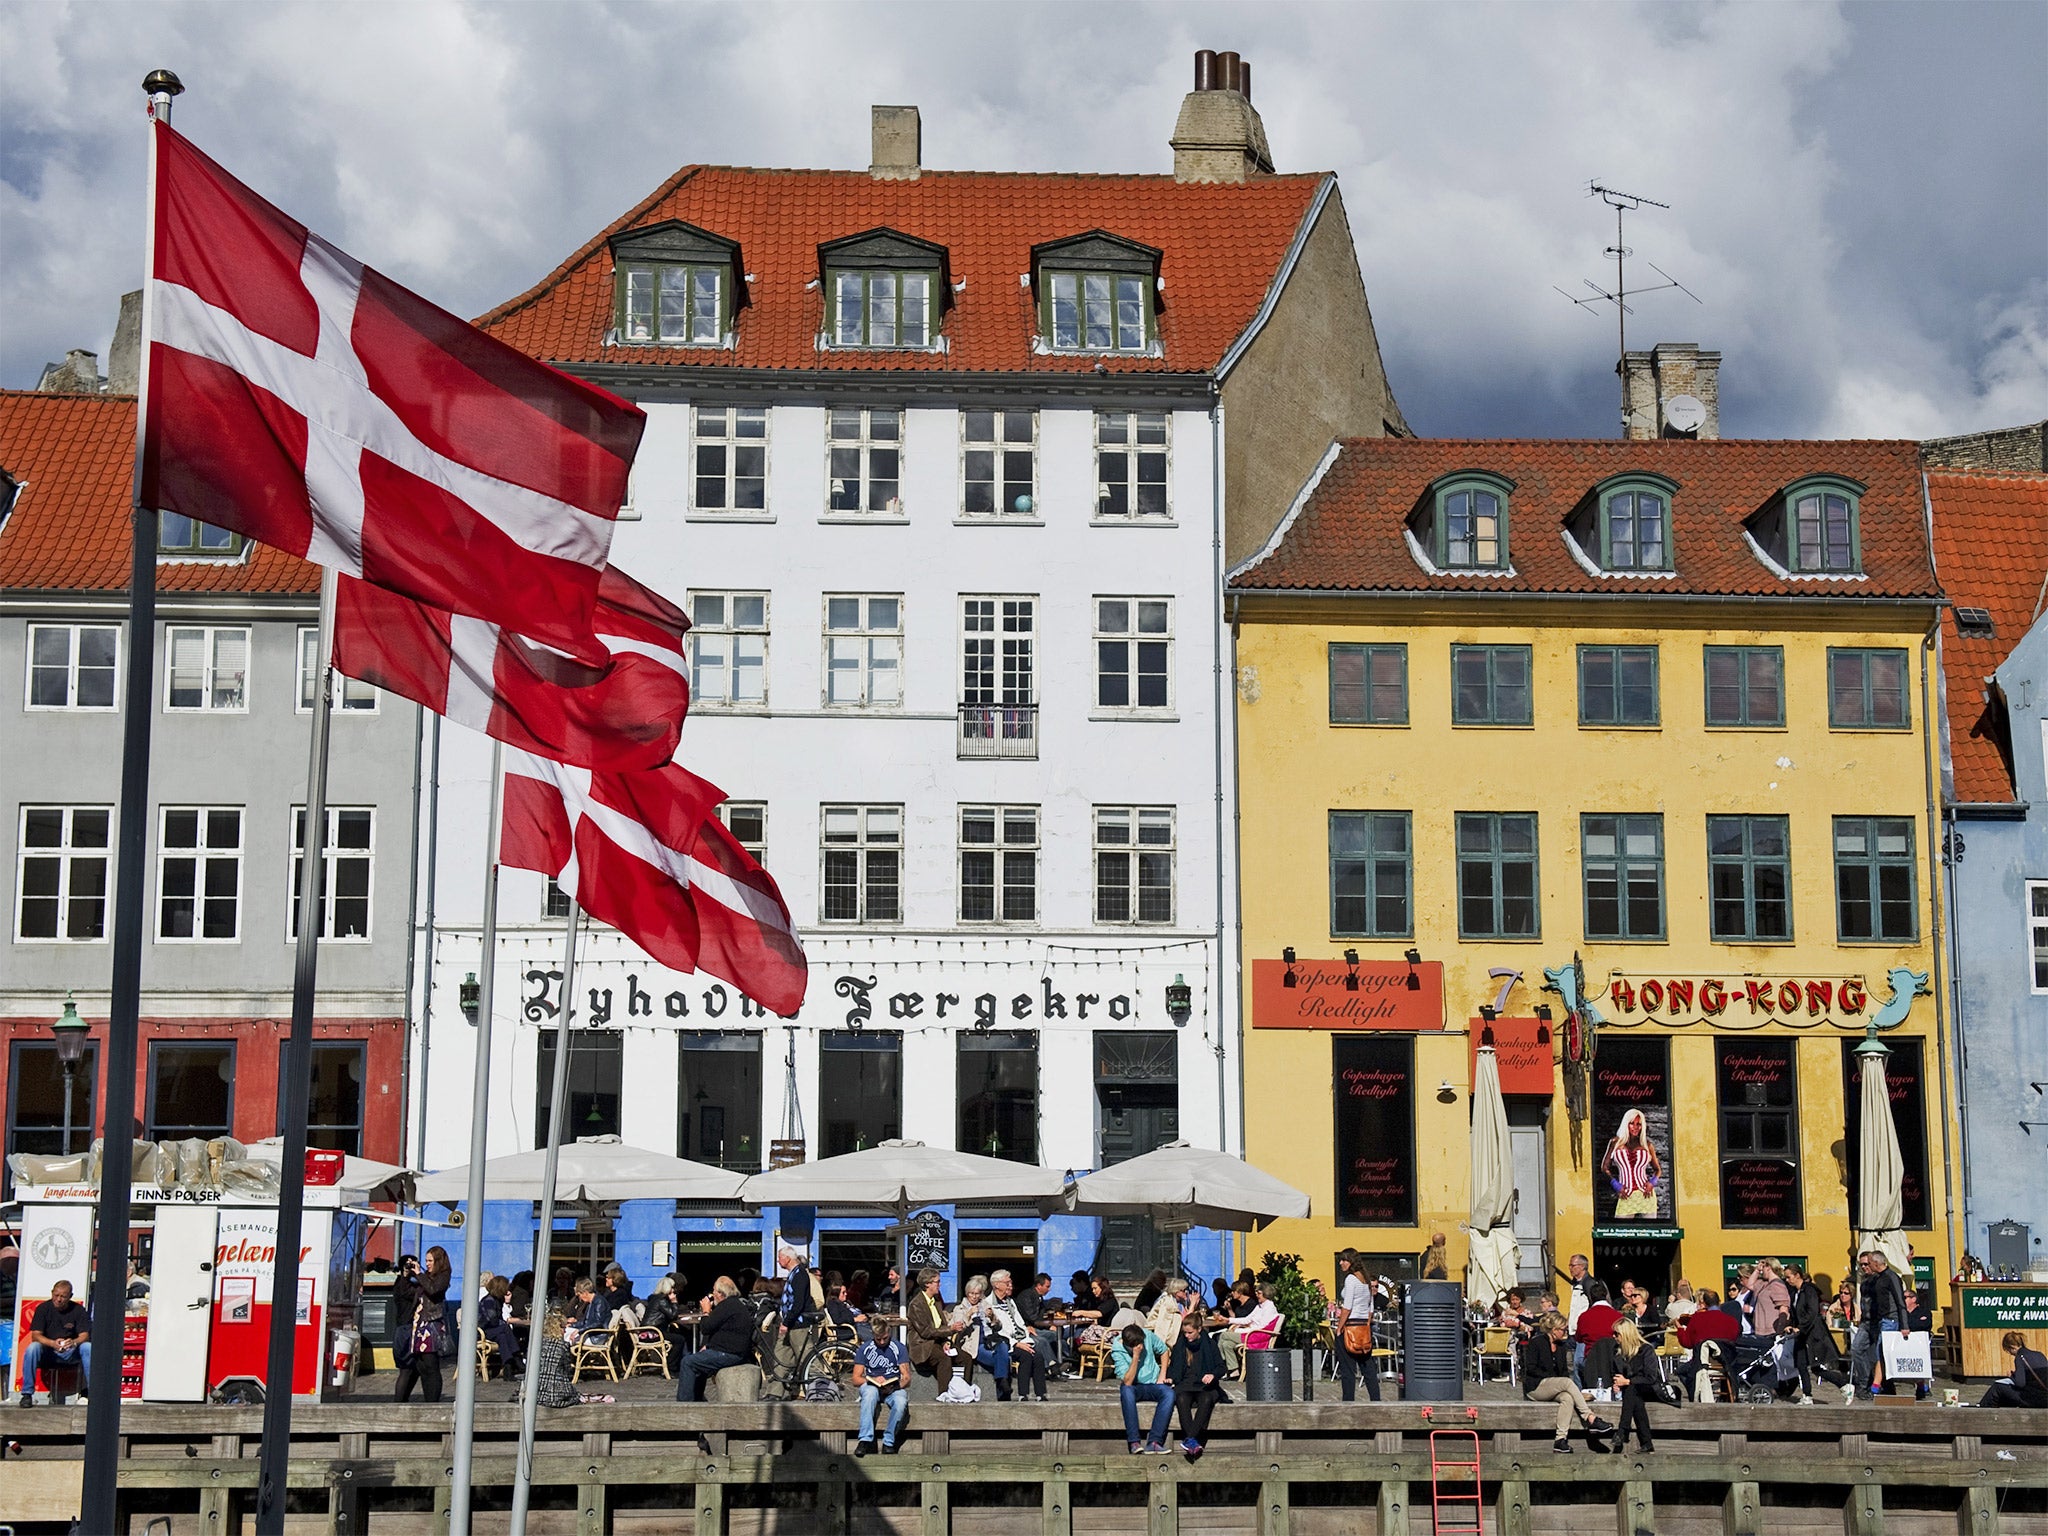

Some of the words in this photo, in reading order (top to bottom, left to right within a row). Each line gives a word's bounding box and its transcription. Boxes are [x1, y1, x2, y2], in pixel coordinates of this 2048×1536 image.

[1488, 967, 1522, 1013] 7
[1611, 979, 1867, 1016] HONG-KONG
[525, 969, 799, 1027] Nyhavn
[834, 974, 1131, 1034] Færgekro
[1298, 995, 1398, 1025] Redlight
[1477, 1037, 1547, 1051] Cpenhagen
[1723, 1054, 1786, 1069] Copenhagen
[1342, 1068, 1405, 1083] Copenhagen
[1598, 1069, 1661, 1084] Copenhagen
[1731, 1070, 1780, 1084] Redlight
[1349, 1084, 1398, 1099] Redlight
[1605, 1085, 1654, 1100] Redlight
[136, 1190, 171, 1200] FINNS
[175, 1189, 221, 1201] PØLSER
[914, 1238, 945, 1248] COFFEE
[215, 1237, 312, 1267] gelænr
[1972, 1296, 2004, 1307] FADØL
[2006, 1296, 2021, 1307] UD
[2023, 1296, 2036, 1307] AF
[1996, 1310, 2021, 1321] TAKE
